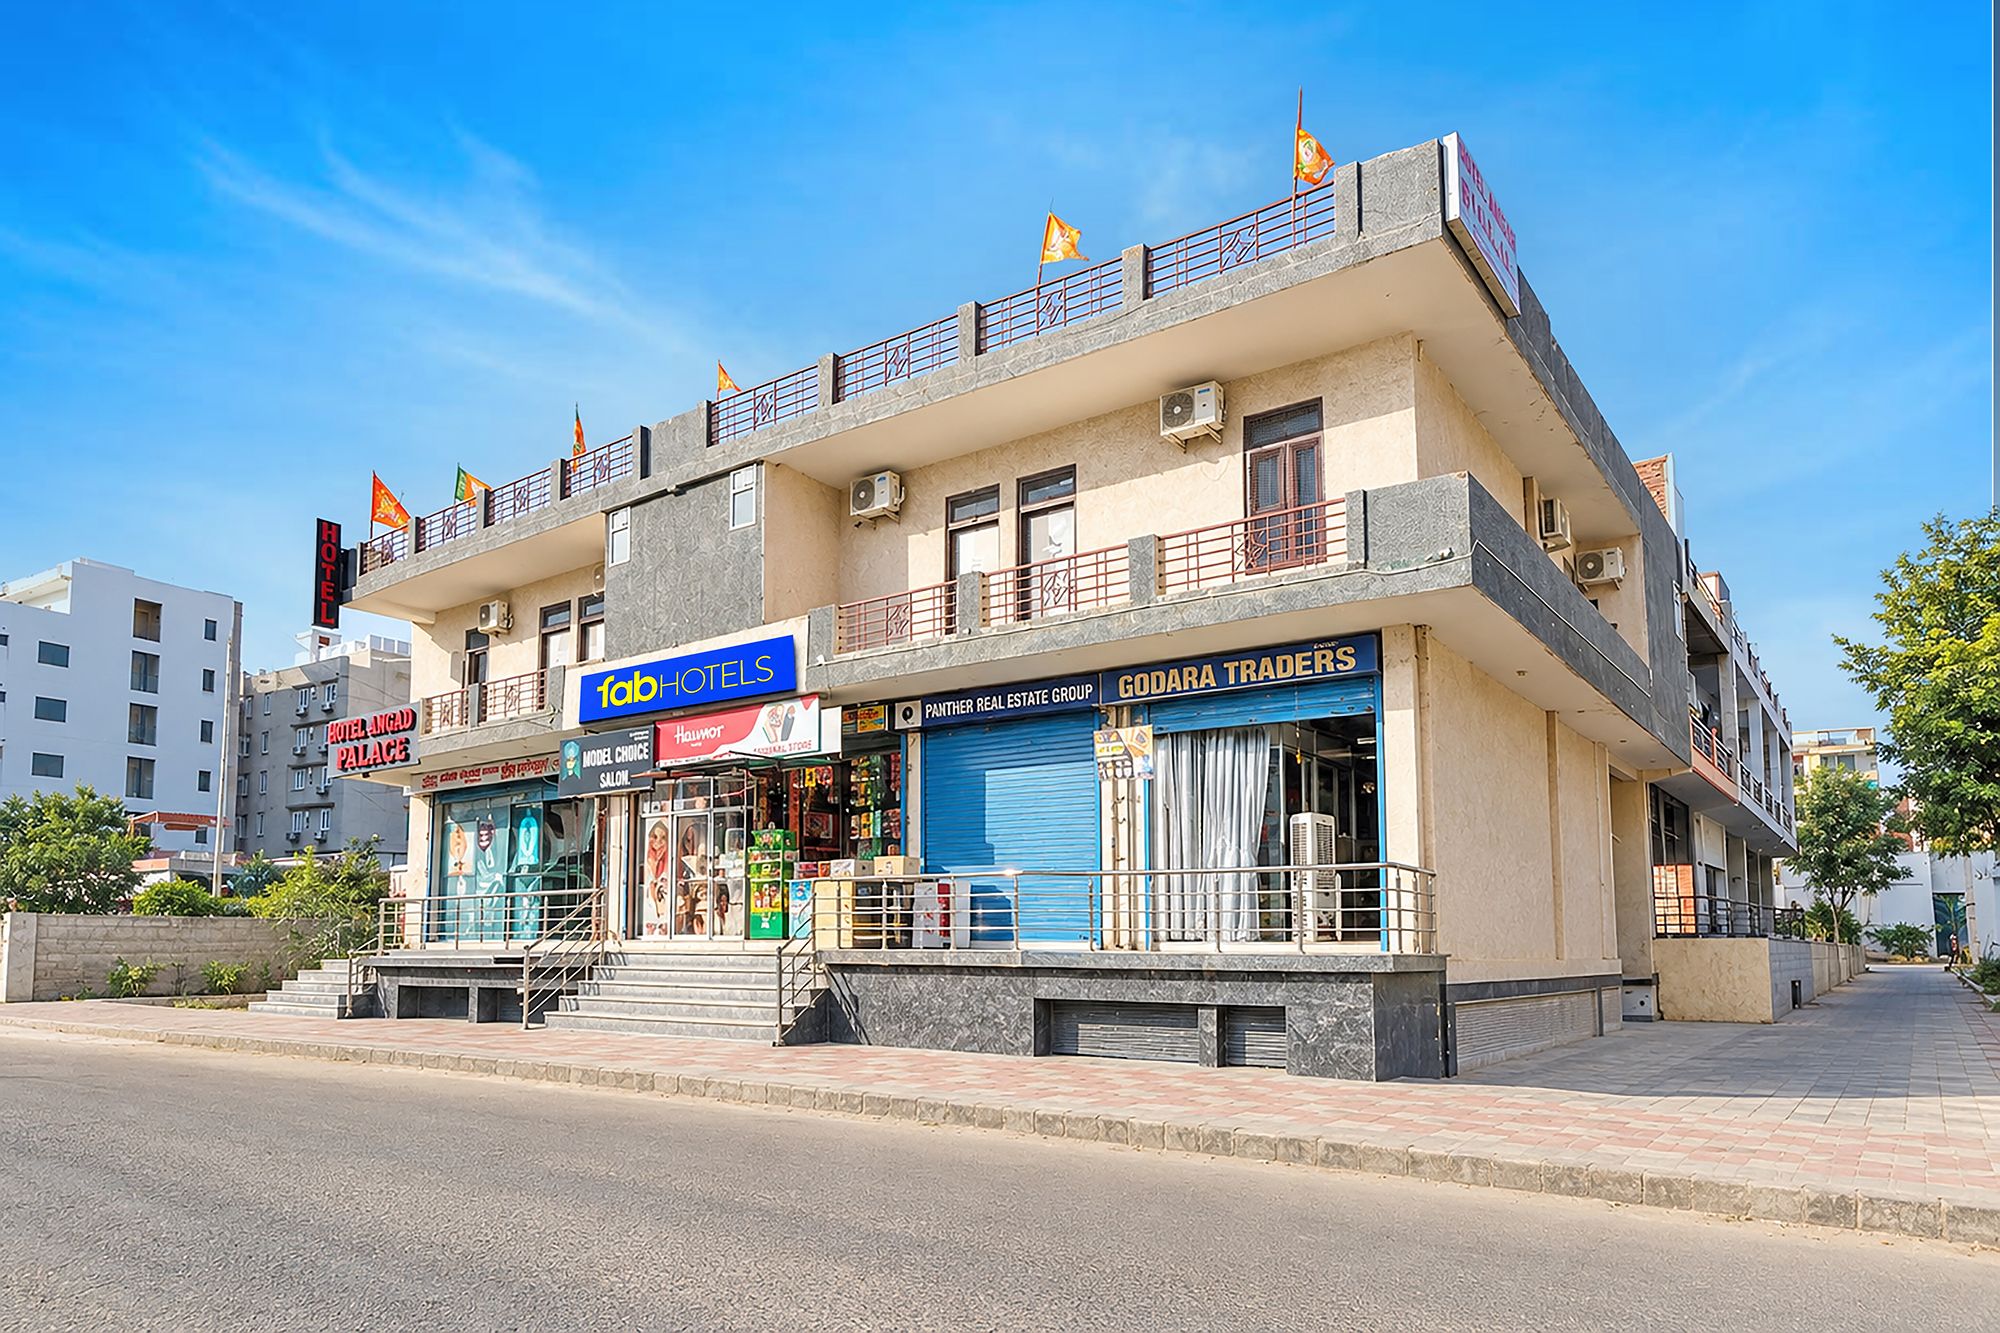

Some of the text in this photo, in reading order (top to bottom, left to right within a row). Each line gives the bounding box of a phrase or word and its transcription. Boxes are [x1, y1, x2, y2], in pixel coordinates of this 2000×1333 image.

[320, 522, 338, 625] HOTEL
[597, 655, 774, 709] fabHOTELS
[1118, 645, 1358, 699] GODARA TRADERS
[925, 683, 1093, 719] PANTHER REAL ESTATE GROUP
[328, 708, 415, 744] HOTEL ANGAD
[336, 738, 409, 771] PALACE
[582, 747, 613, 768] MODEL
[615, 742, 649, 763] CHOICE
